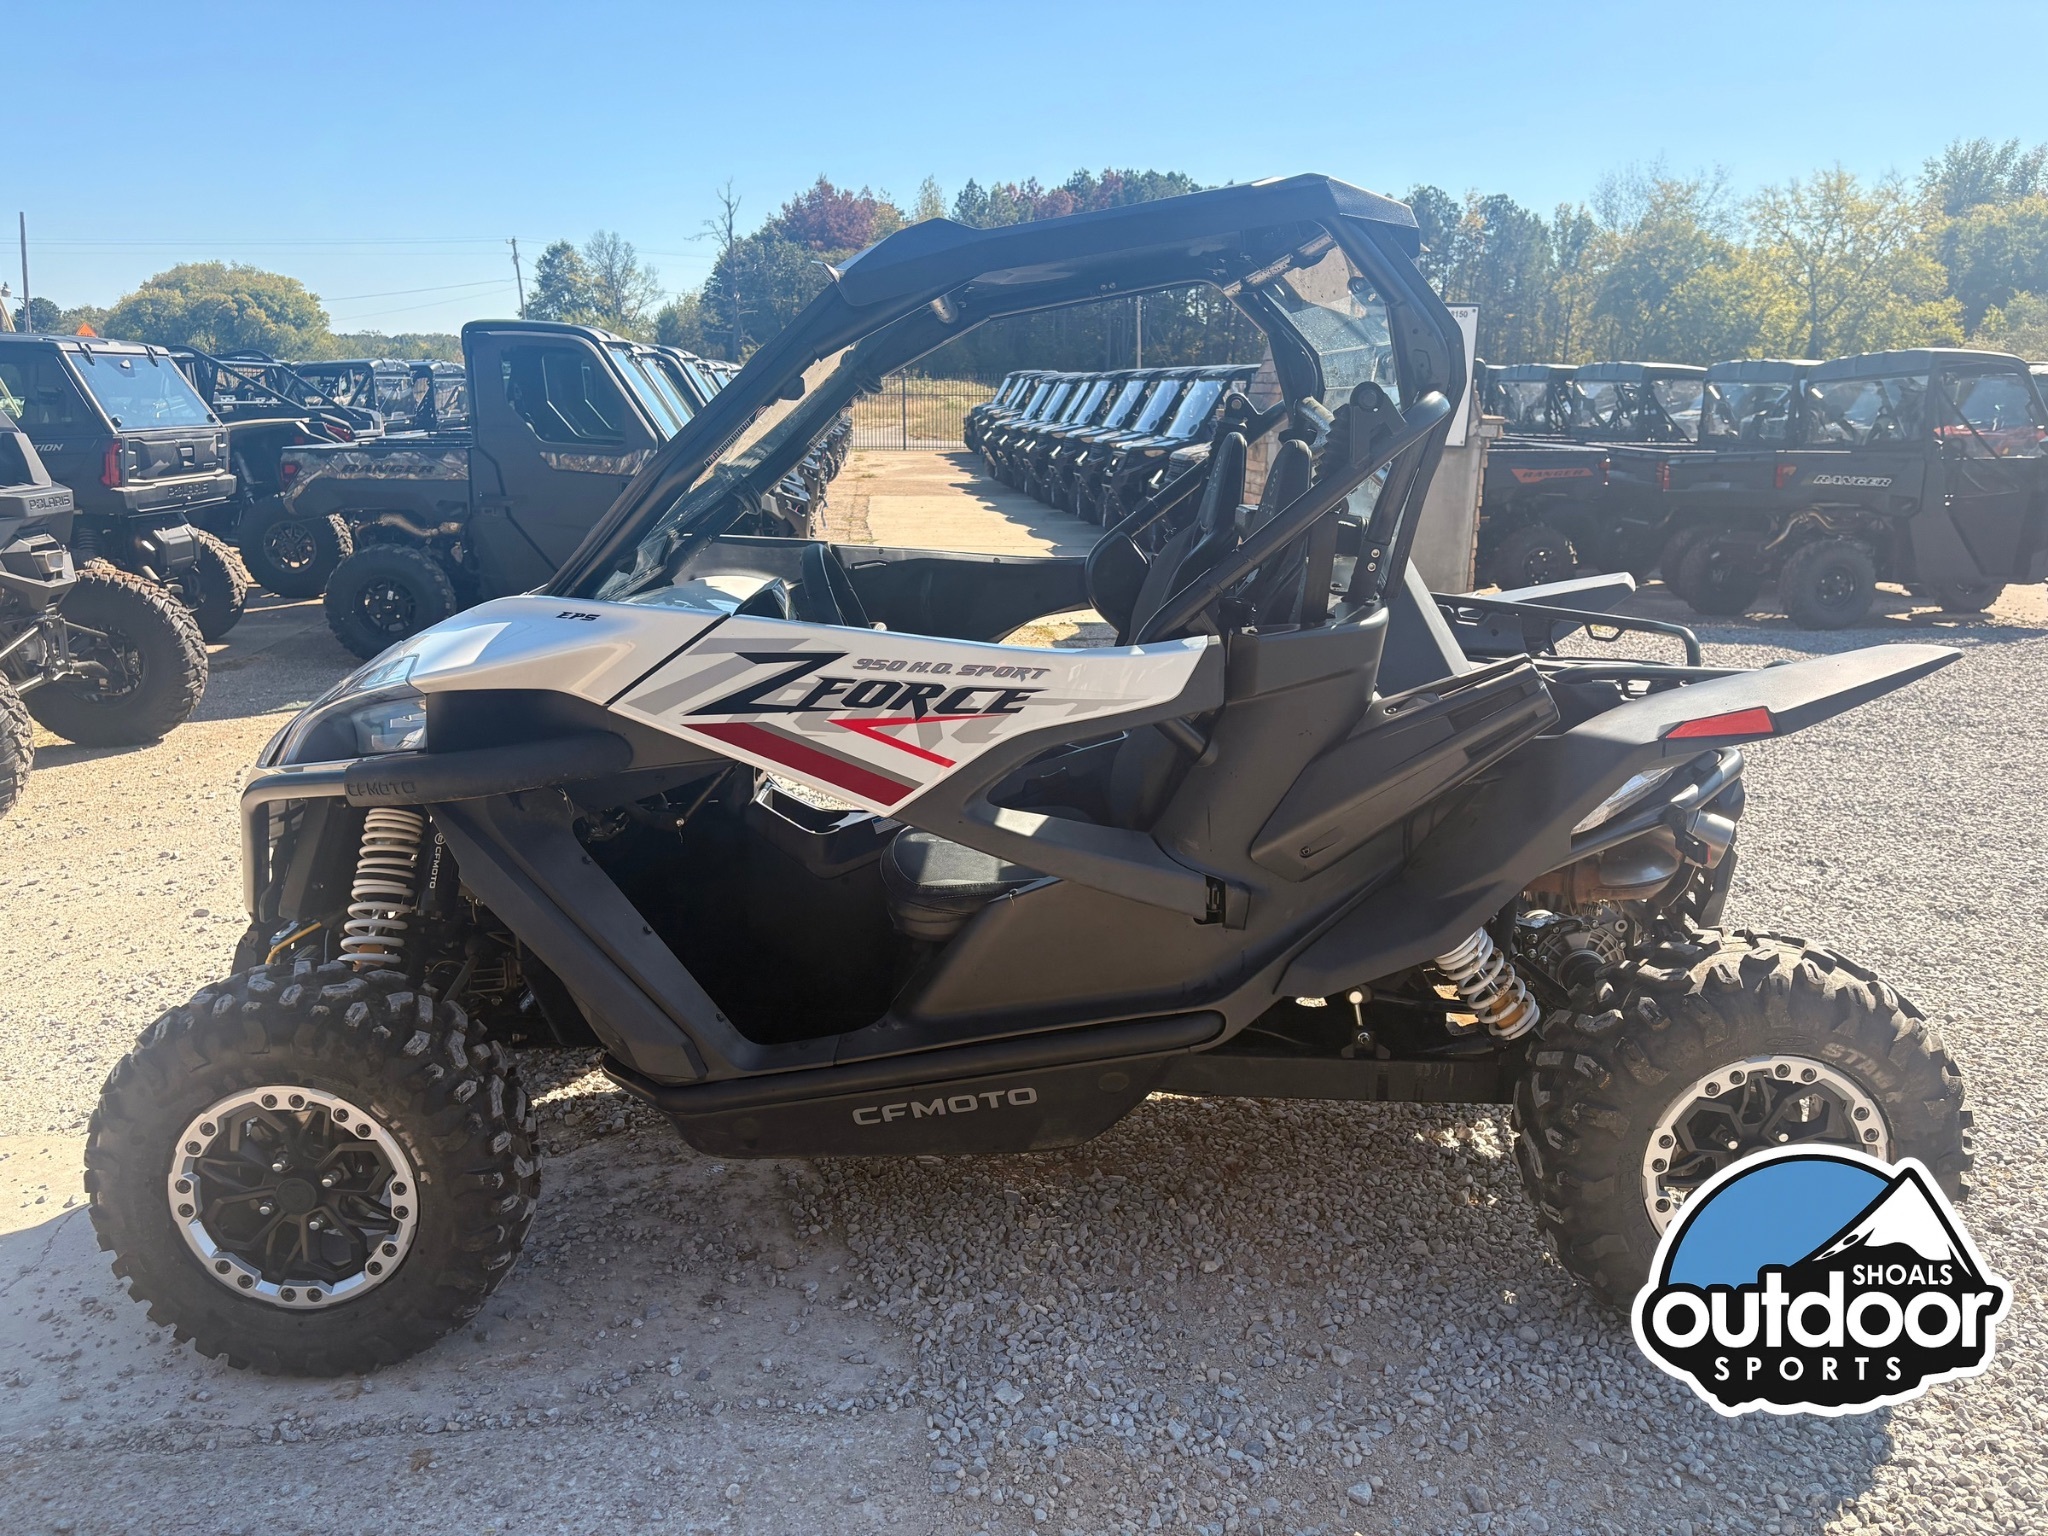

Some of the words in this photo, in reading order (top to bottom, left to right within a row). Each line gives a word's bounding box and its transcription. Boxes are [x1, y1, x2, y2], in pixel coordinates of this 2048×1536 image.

[340, 464, 435, 474] RANGER
[1522, 469, 1584, 478] RANGER
[1813, 475, 1892, 487] RANGER
[29, 495, 71, 510] POLARIS
[555, 611, 601, 621] EPS
[852, 658, 907, 673] 950
[908, 660, 952, 675] H.O.
[956, 664, 1051, 682] SPORT
[347, 781, 416, 797] CFMOTO
[429, 846, 442, 889] CFMOTO
[852, 1087, 1038, 1126] CFMOTO
